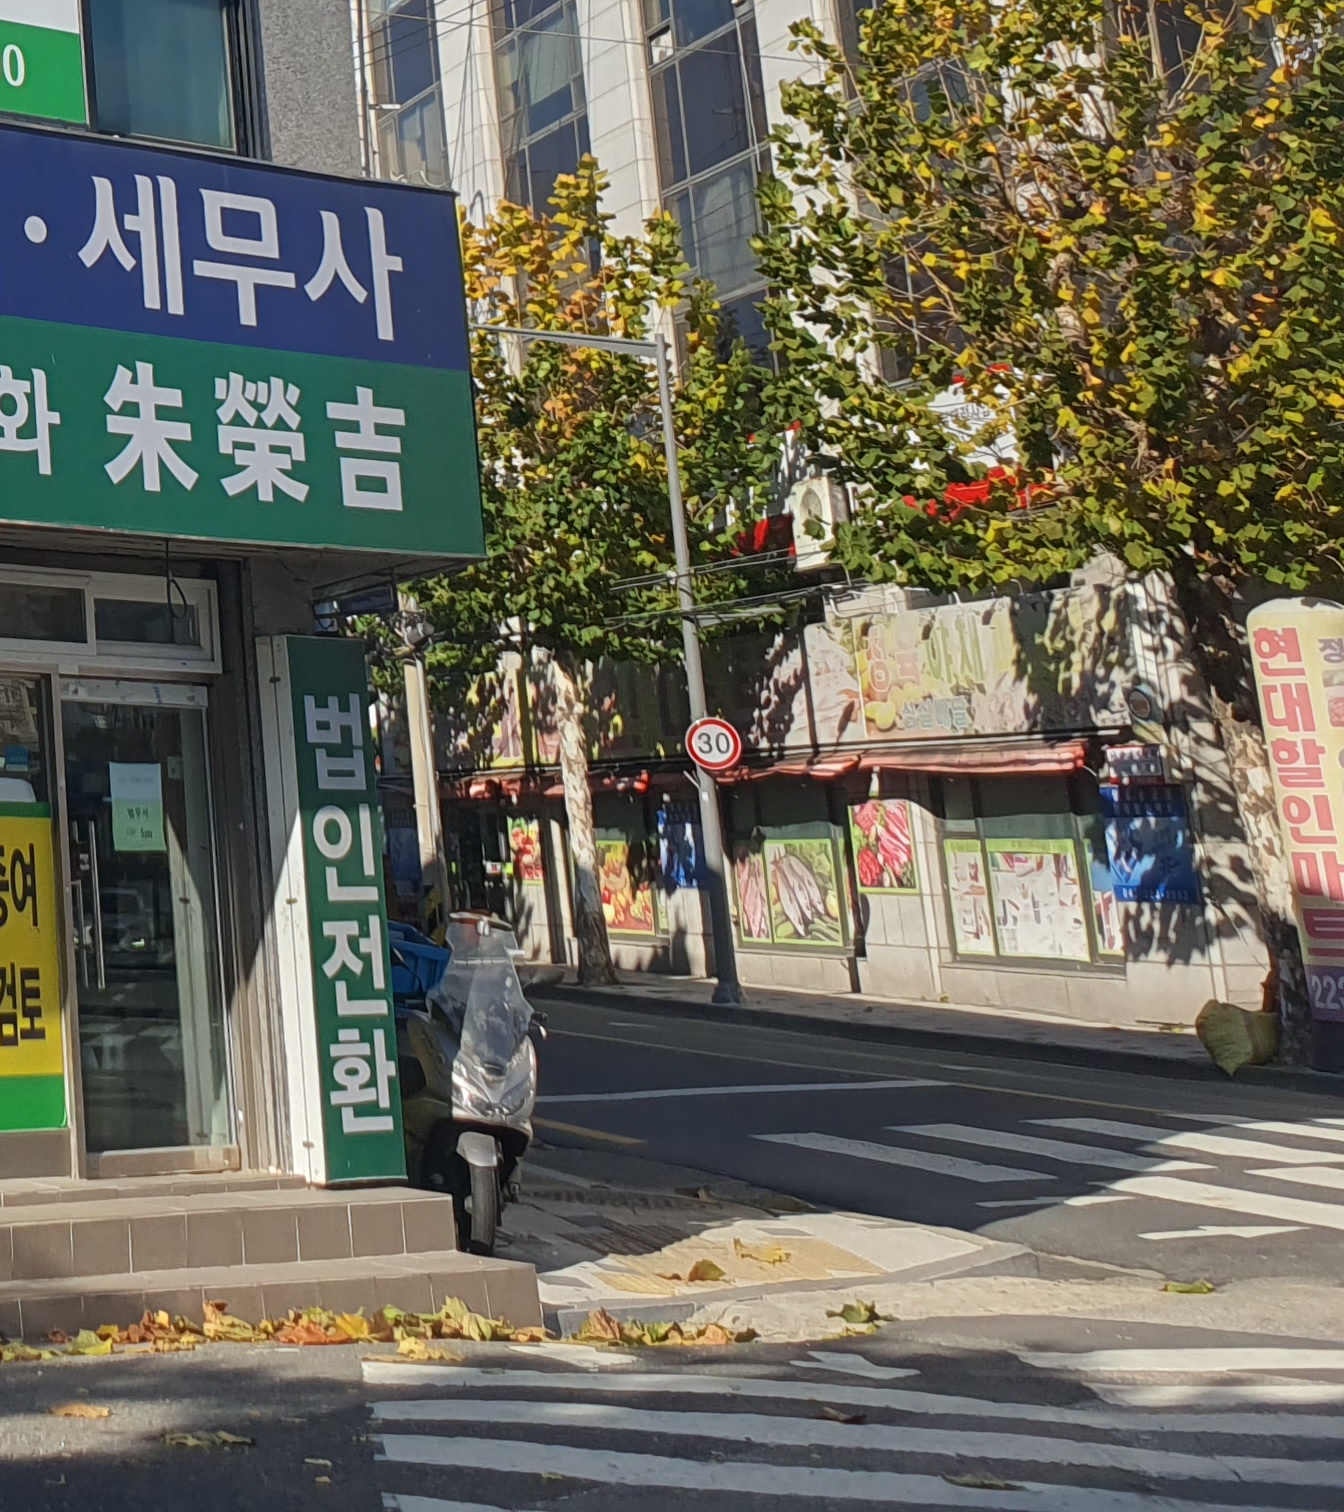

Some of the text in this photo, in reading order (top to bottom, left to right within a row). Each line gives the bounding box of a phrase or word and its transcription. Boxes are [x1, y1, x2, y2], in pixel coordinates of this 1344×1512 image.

[103, 359, 407, 512] 朱榮吉
[697, 732, 731, 755] 30
[304, 692, 398, 1134] 법인전환
